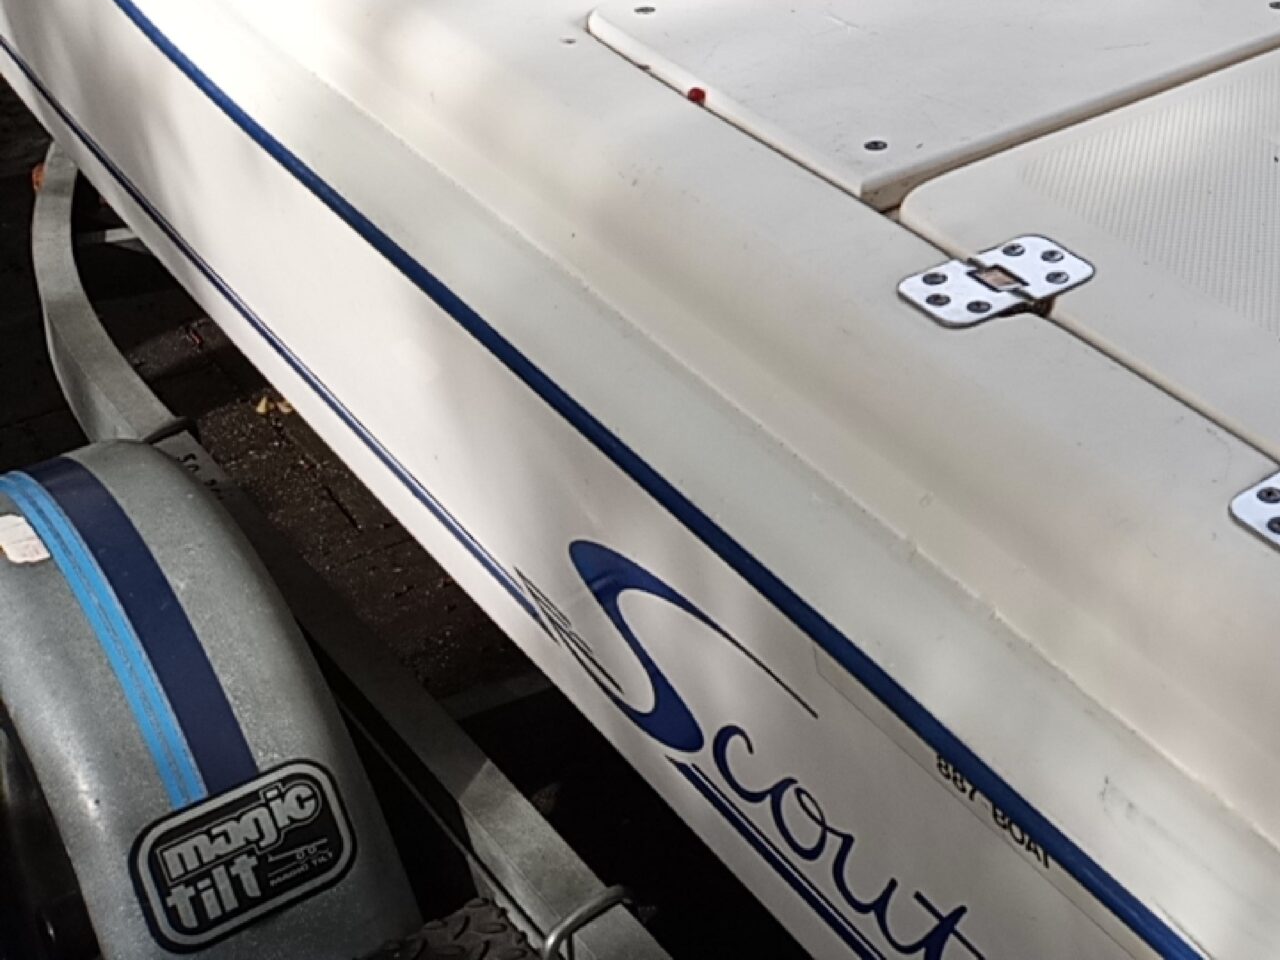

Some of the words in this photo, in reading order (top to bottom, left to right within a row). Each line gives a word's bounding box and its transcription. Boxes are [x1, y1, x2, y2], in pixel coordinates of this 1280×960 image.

[514, 539, 986, 960] Scout
[161, 783, 318, 880] magic
[165, 852, 262, 929] tilt
